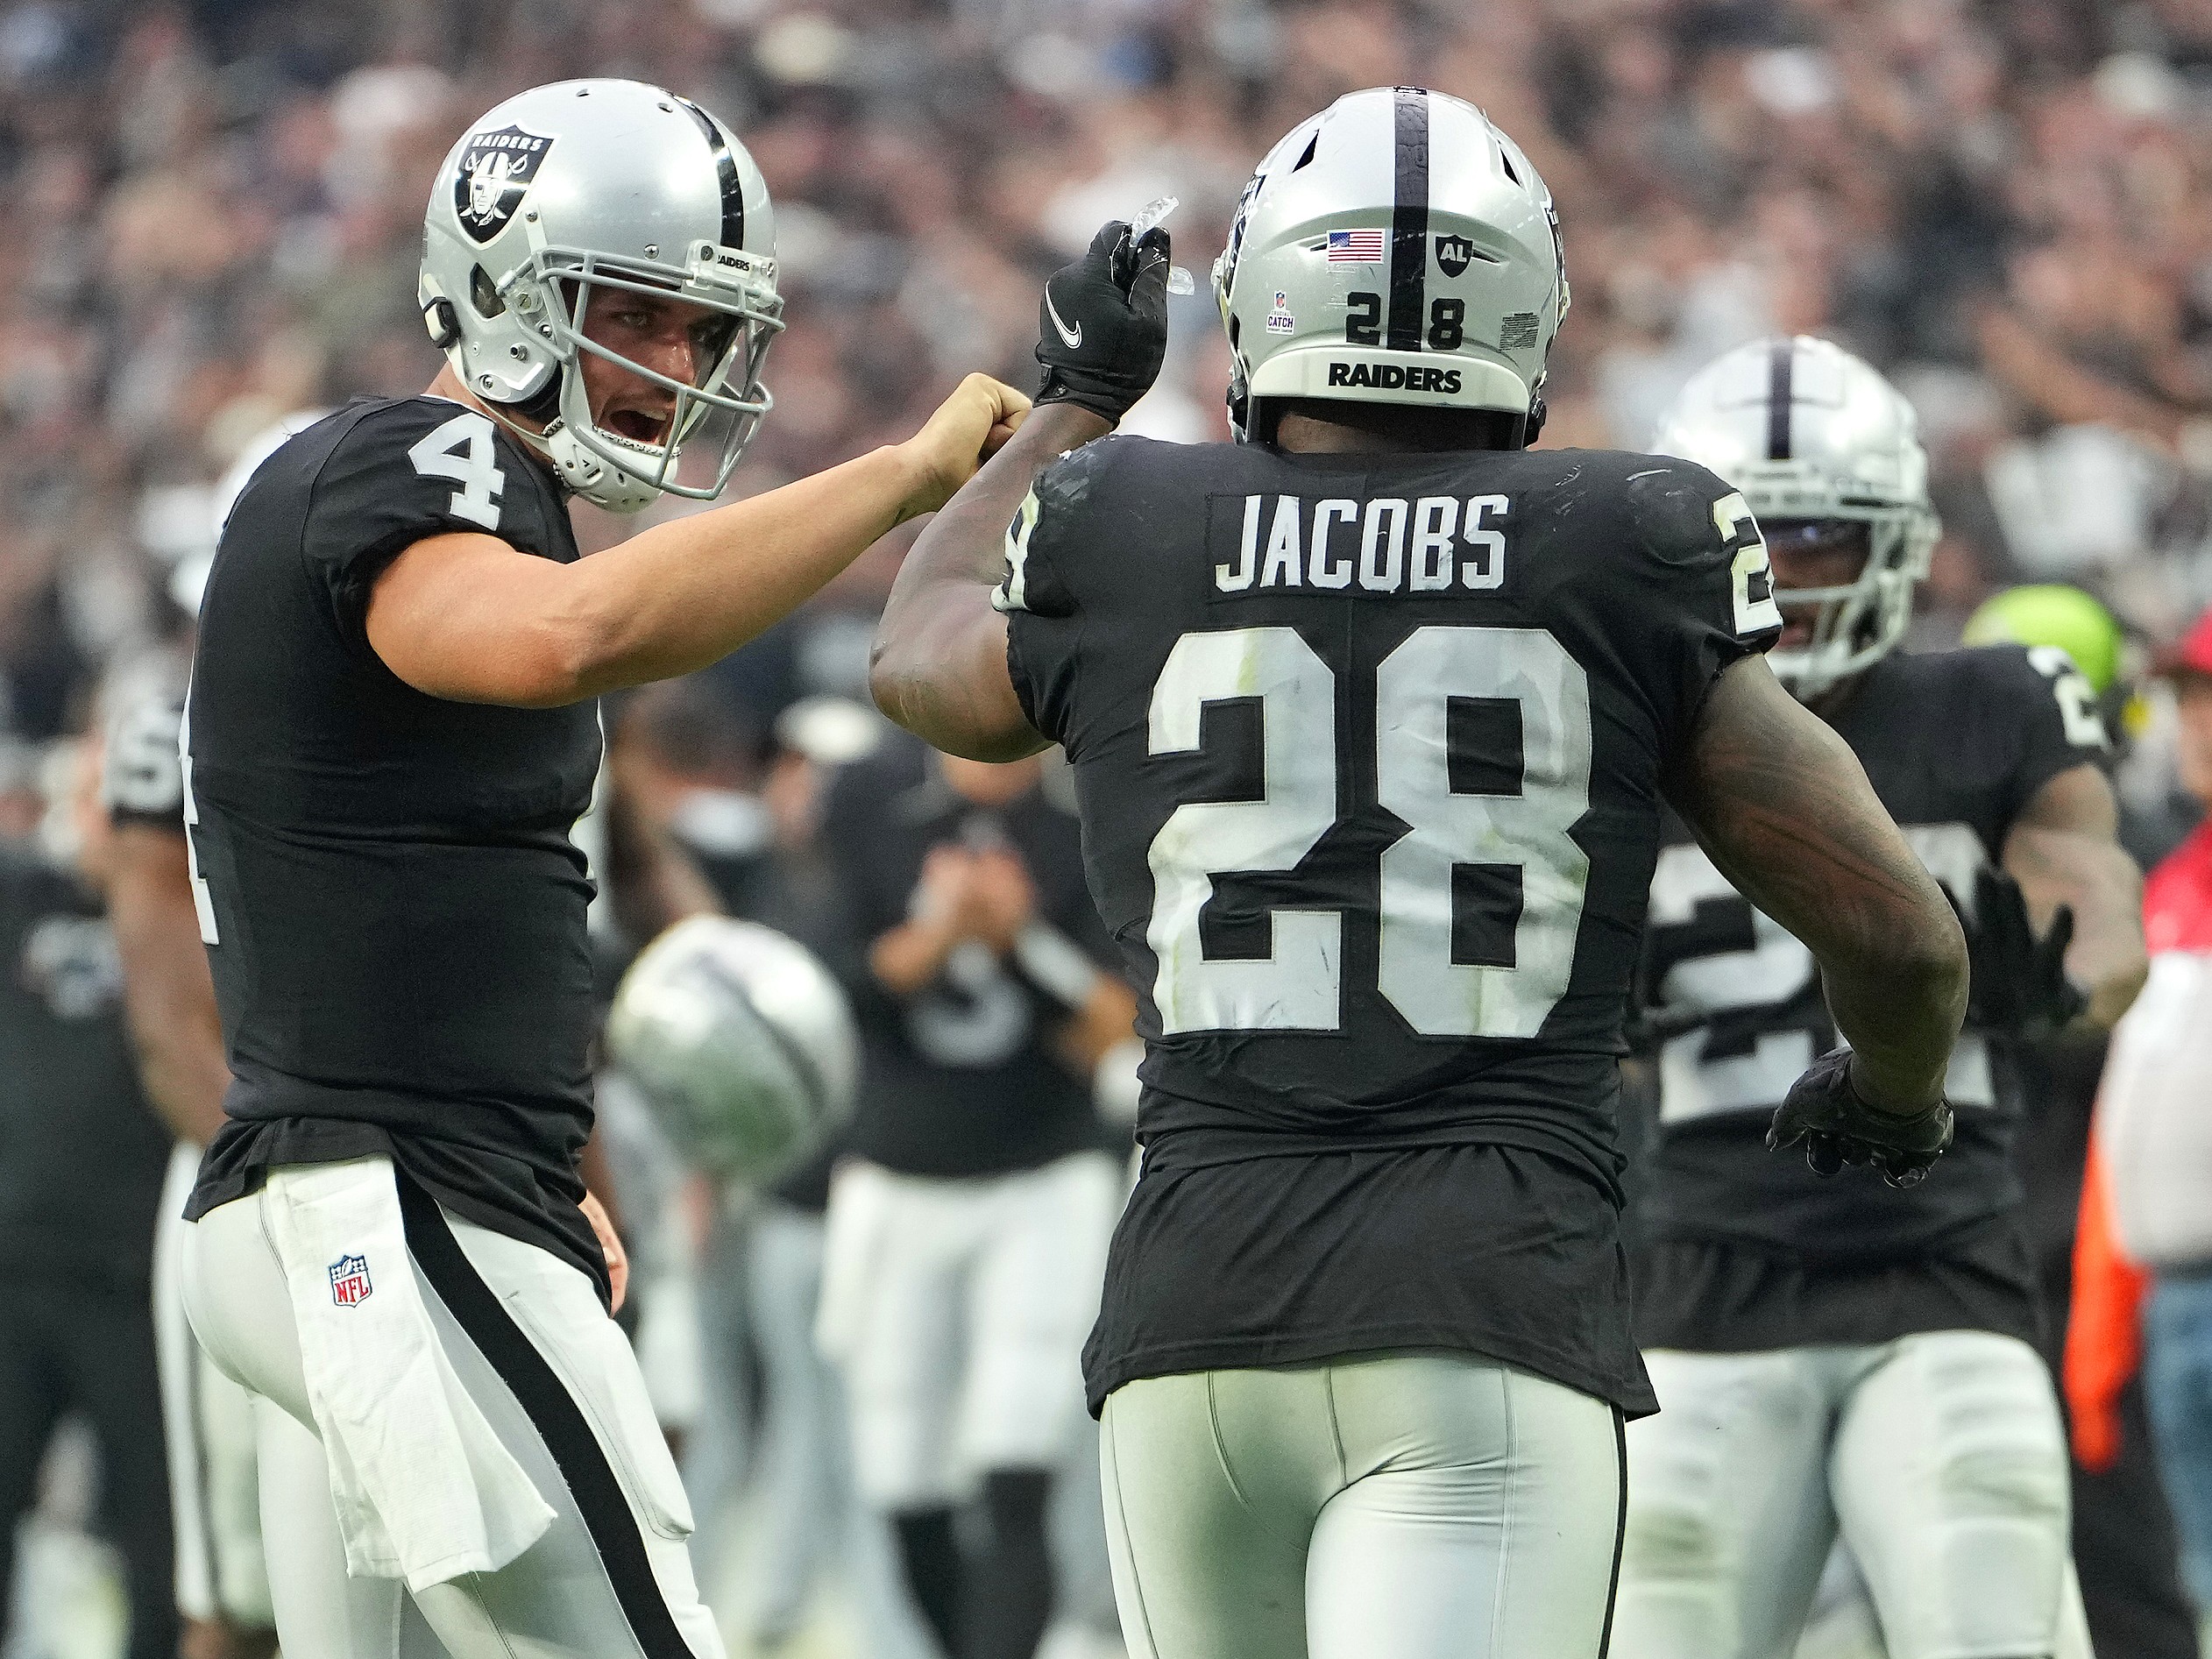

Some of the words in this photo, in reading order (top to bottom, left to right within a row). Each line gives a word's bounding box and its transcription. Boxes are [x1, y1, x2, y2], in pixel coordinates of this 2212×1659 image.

[471, 135, 543, 152] RAIDERS
[1440, 243, 1468, 263] AL
[1267, 316, 1294, 329] CATCH
[1328, 363, 1462, 393] RAIDERS
[408, 412, 505, 531] 4
[1216, 494, 1509, 593] JACOBS
[1147, 626, 1592, 1039] 28
[335, 1276, 369, 1303] NFL
